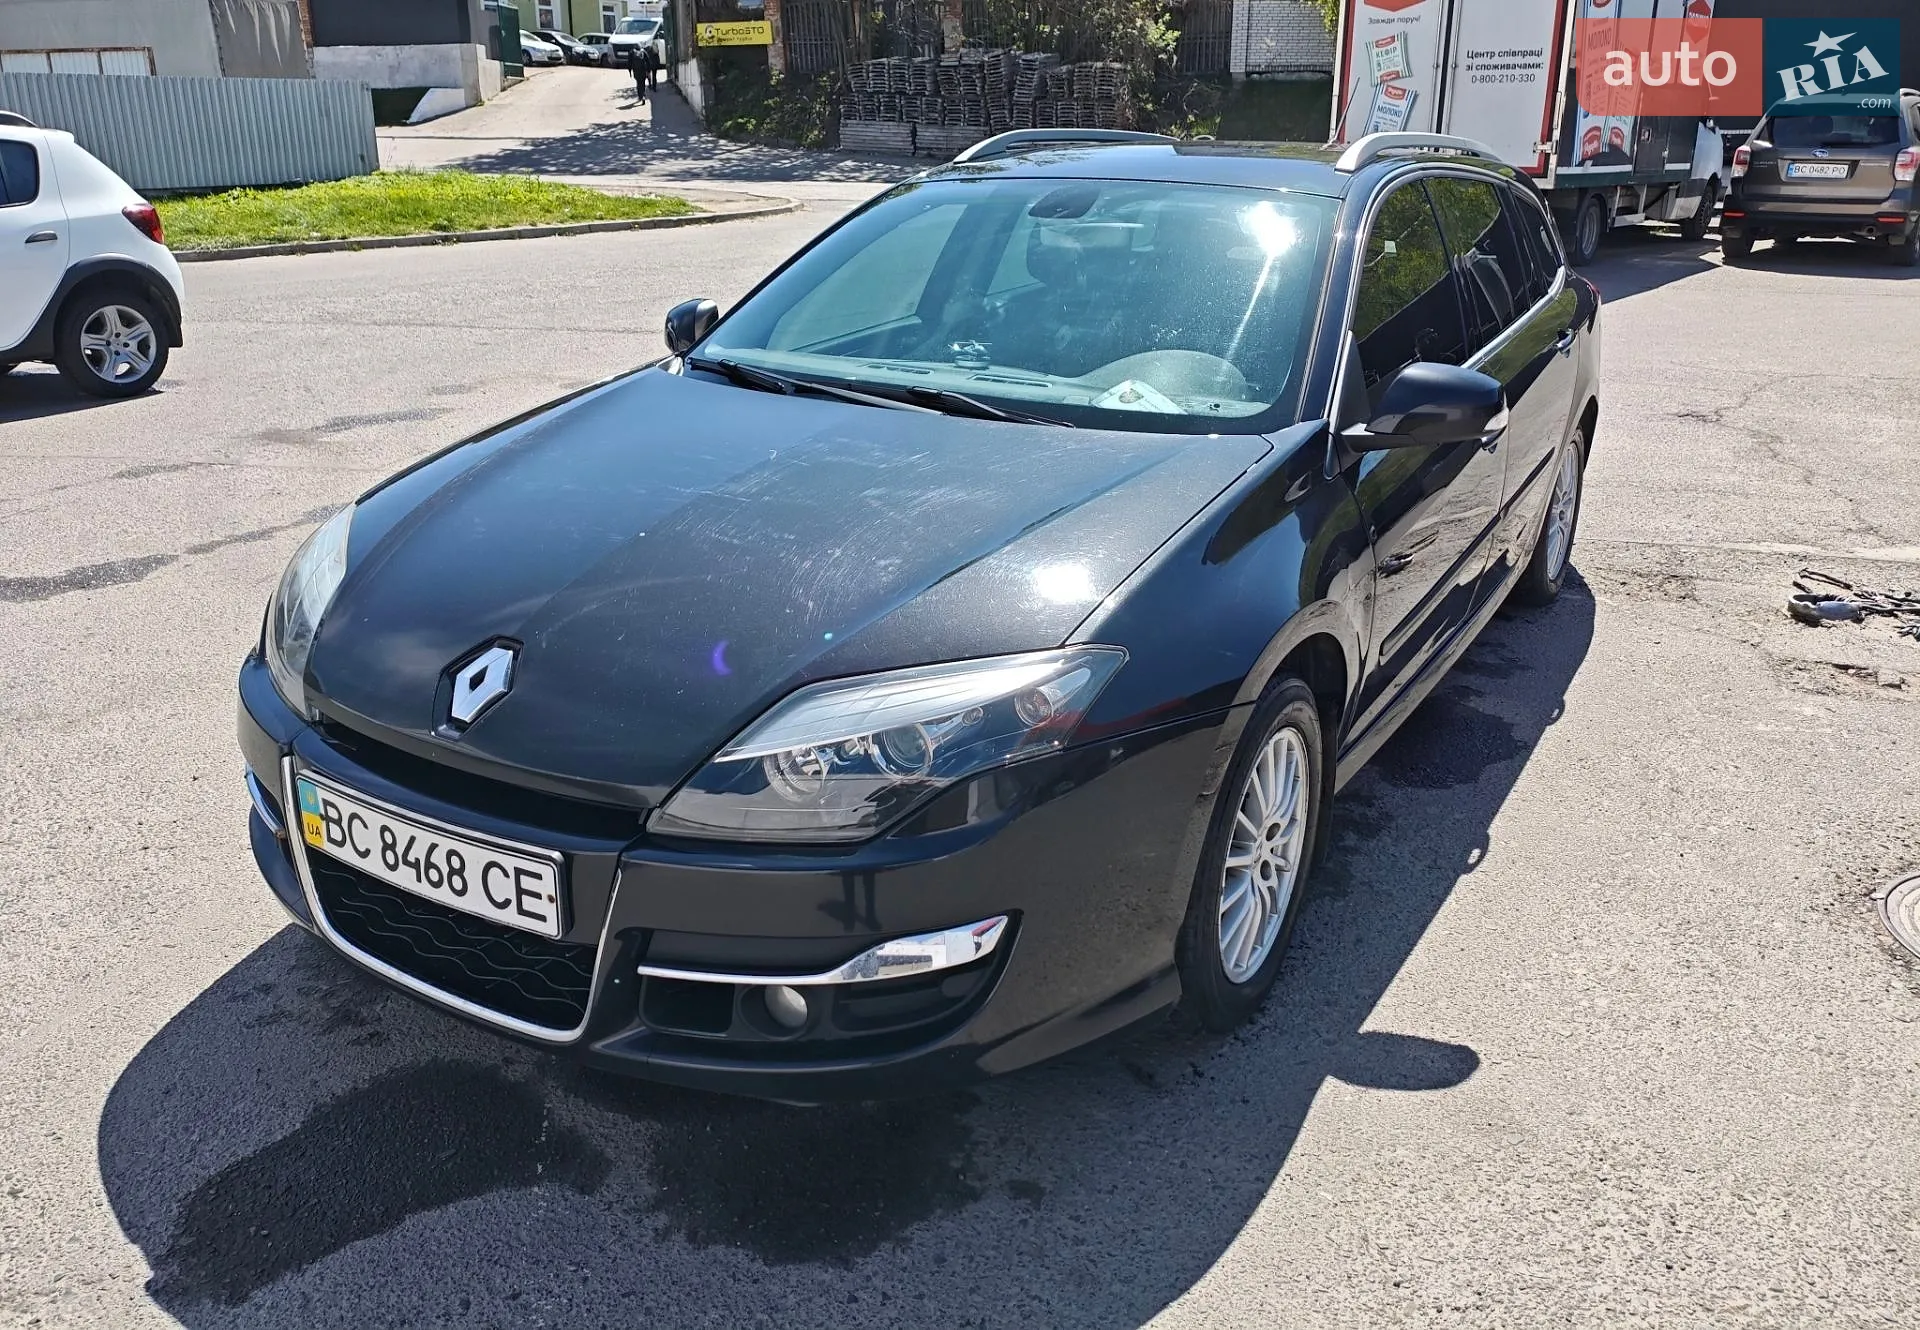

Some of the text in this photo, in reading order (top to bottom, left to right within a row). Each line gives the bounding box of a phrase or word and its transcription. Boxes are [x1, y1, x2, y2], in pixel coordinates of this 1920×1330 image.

[1367, 14, 1421, 25] Завжди поруч!
[1466, 47, 1543, 60] Центр співпраці
[1465, 62, 1544, 71] зі споживачами:
[1471, 73, 1536, 84] 0-800-210-330
[1794, 166, 1808, 174] BC
[1832, 166, 1845, 175] PO
[306, 822, 322, 838] UA
[321, 798, 548, 923] BC 8468 CE
